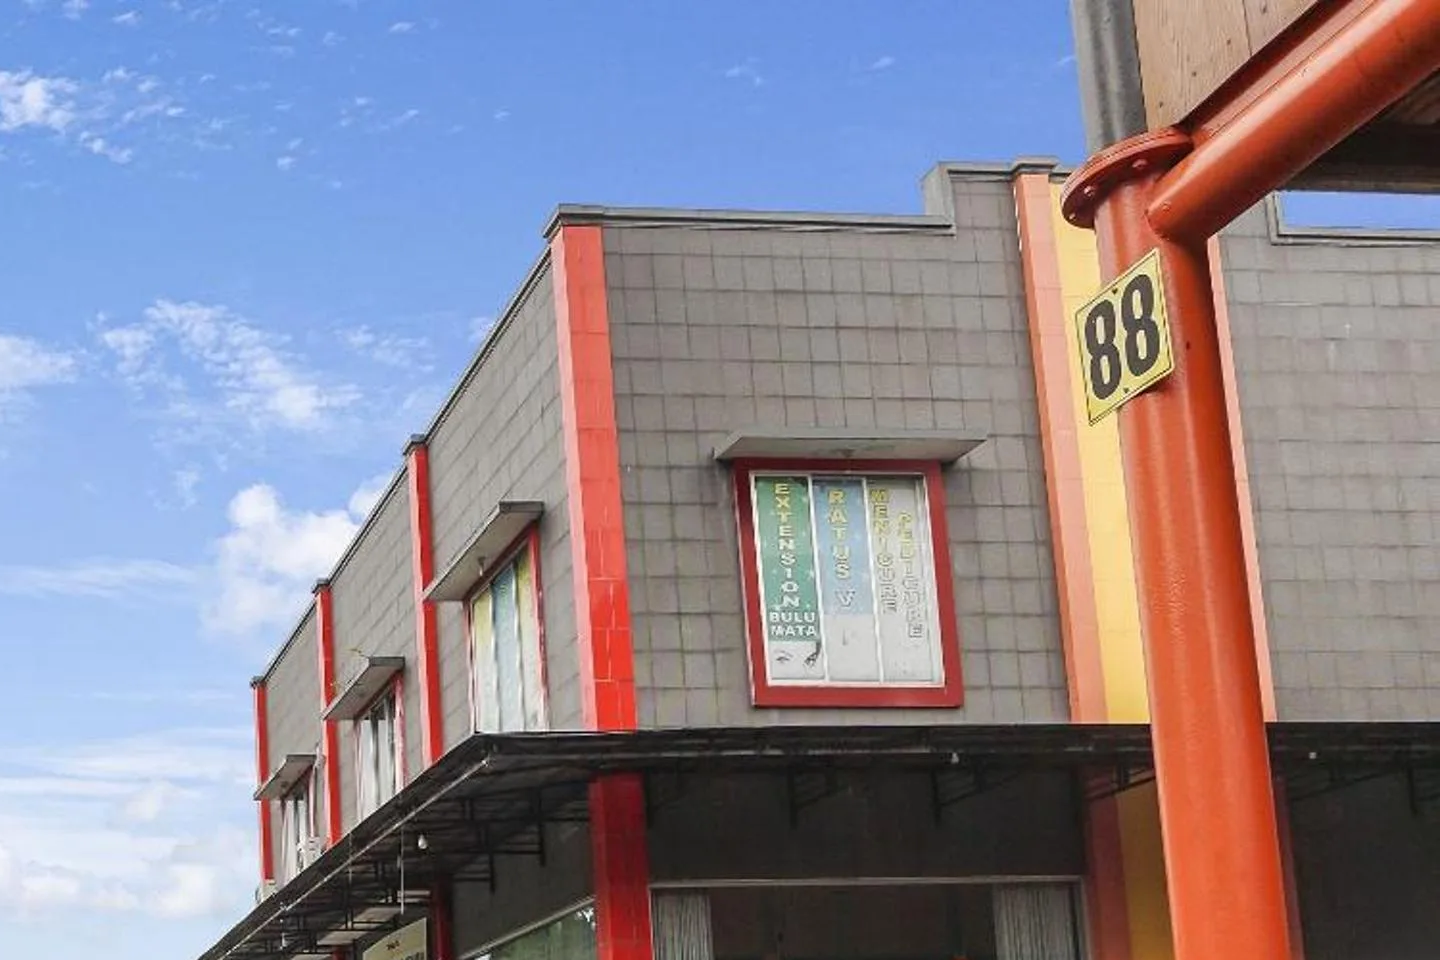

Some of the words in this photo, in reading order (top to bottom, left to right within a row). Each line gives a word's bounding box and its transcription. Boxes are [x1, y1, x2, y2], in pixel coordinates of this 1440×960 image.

[1085, 274, 1160, 400] 88
[774, 483, 801, 608] EXTENSION
[828, 490, 851, 580] RATUS
[769, 611, 816, 624] BULU
[770, 625, 818, 637] MATA
